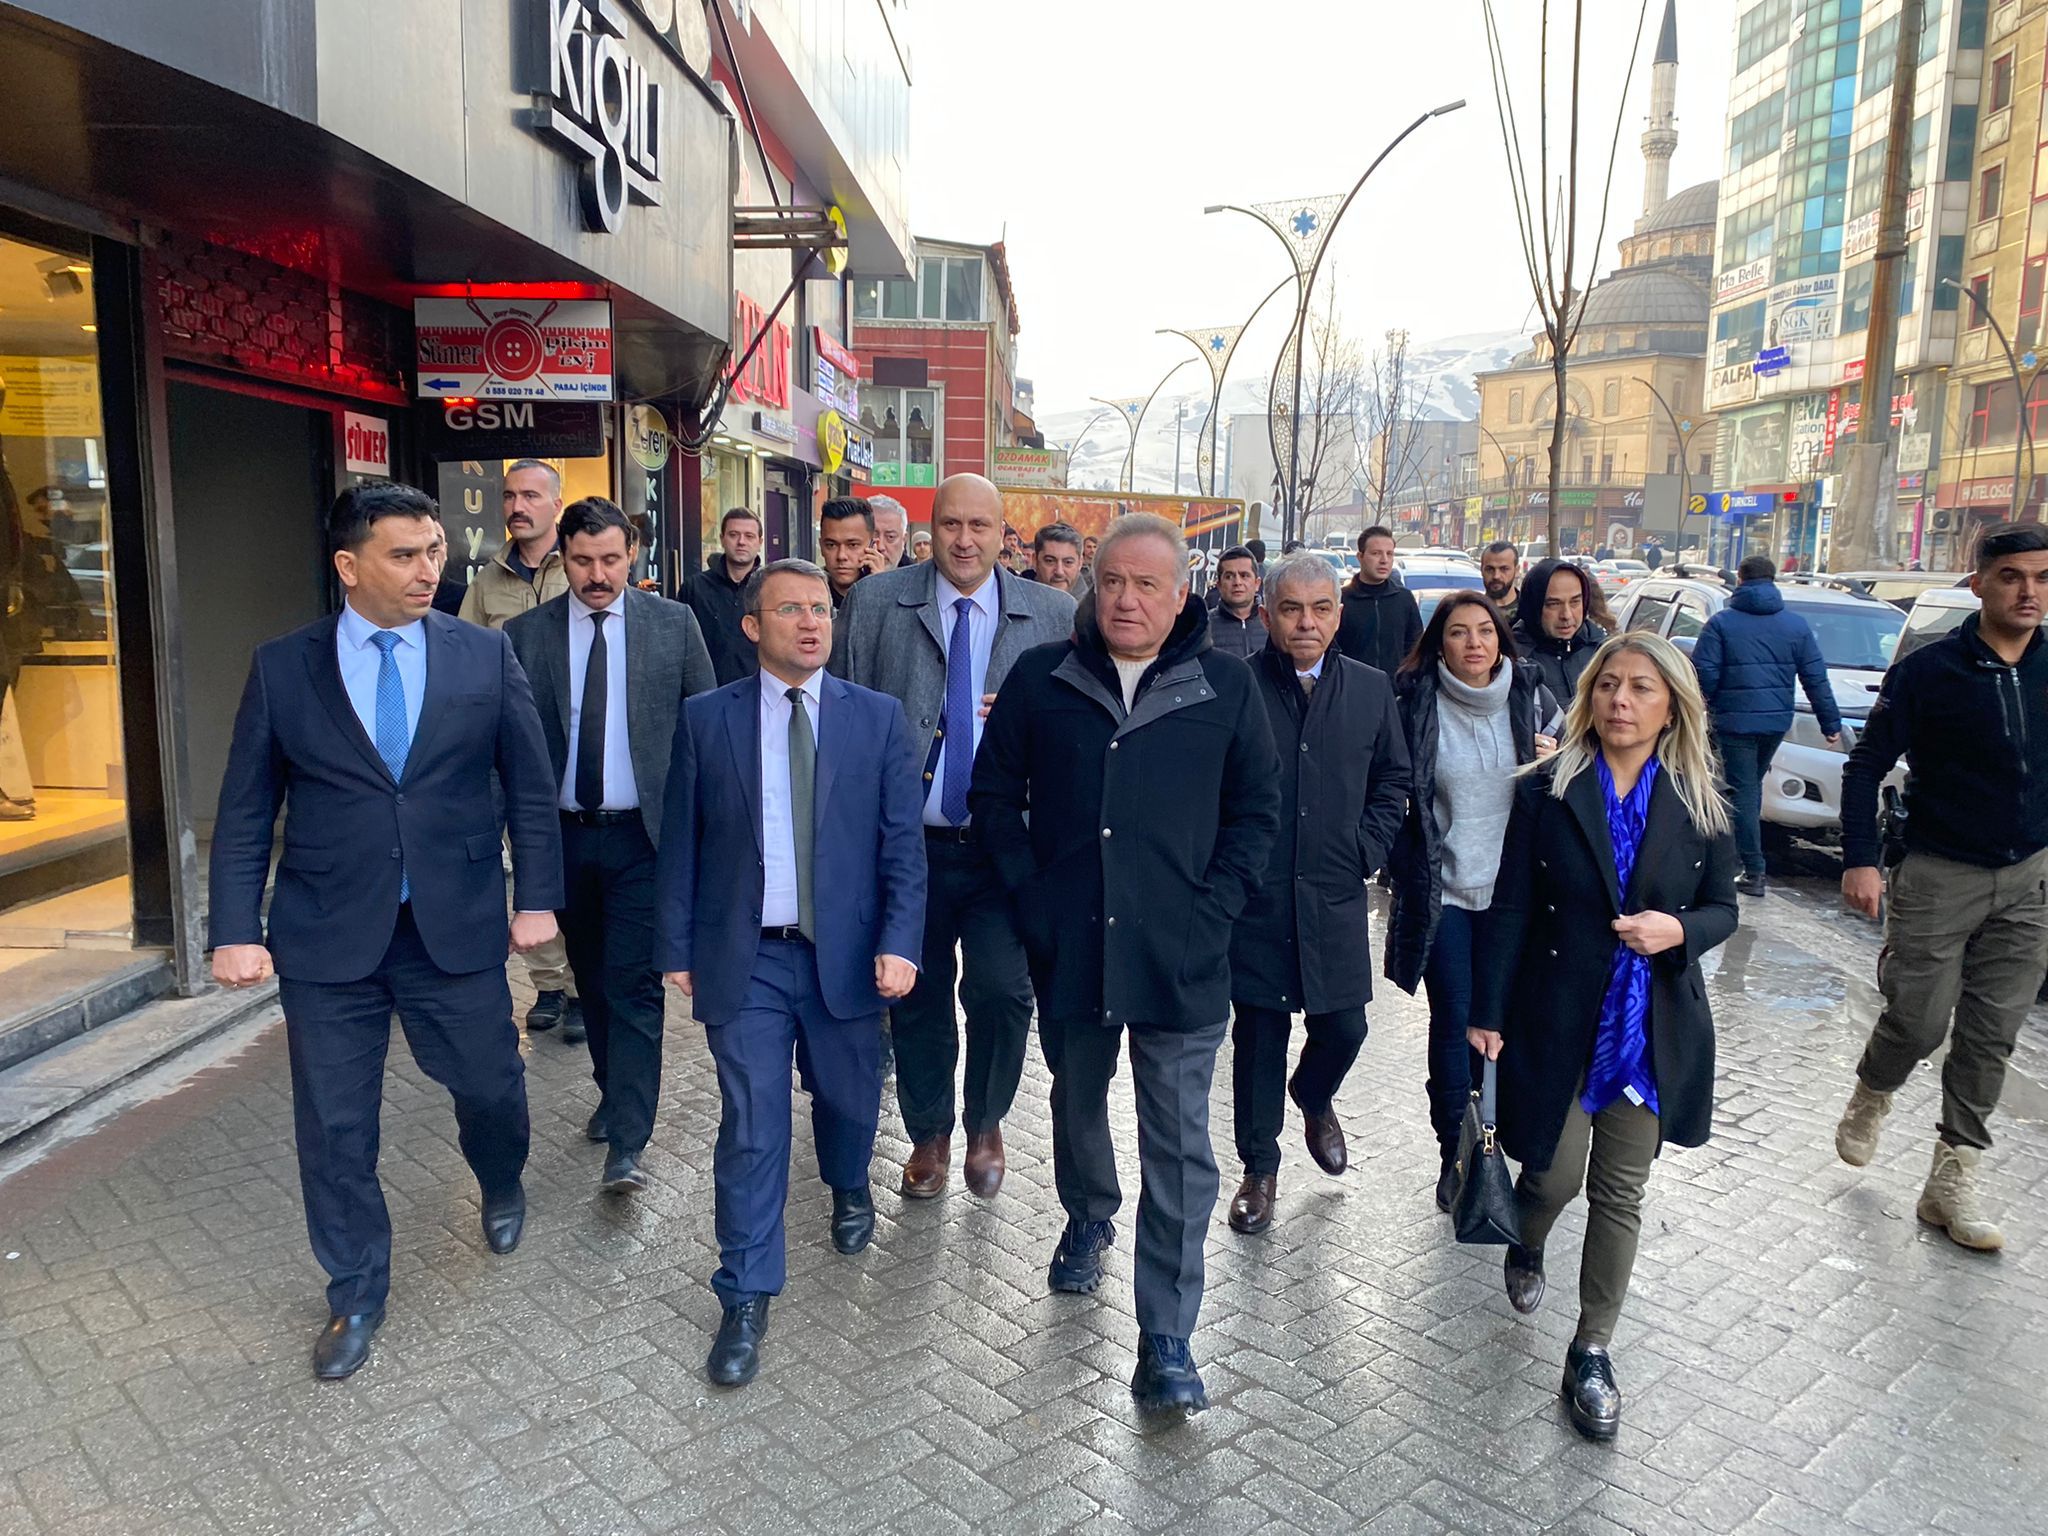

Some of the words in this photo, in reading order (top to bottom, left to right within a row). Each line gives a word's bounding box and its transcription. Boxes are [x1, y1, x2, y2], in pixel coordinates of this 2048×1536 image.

[1719, 274, 1735, 291] Ma
[1738, 262, 1764, 283] Belle
[1783, 311, 1809, 328] SGK
[419, 336, 481, 365] Sümer
[722, 290, 792, 410] TAN
[554, 383, 578, 392] PASAJ
[580, 382, 608, 393] İÇİNDE
[1721, 364, 1753, 386] ALFA
[444, 403, 535, 430] GSM
[346, 421, 387, 465] SÜMER
